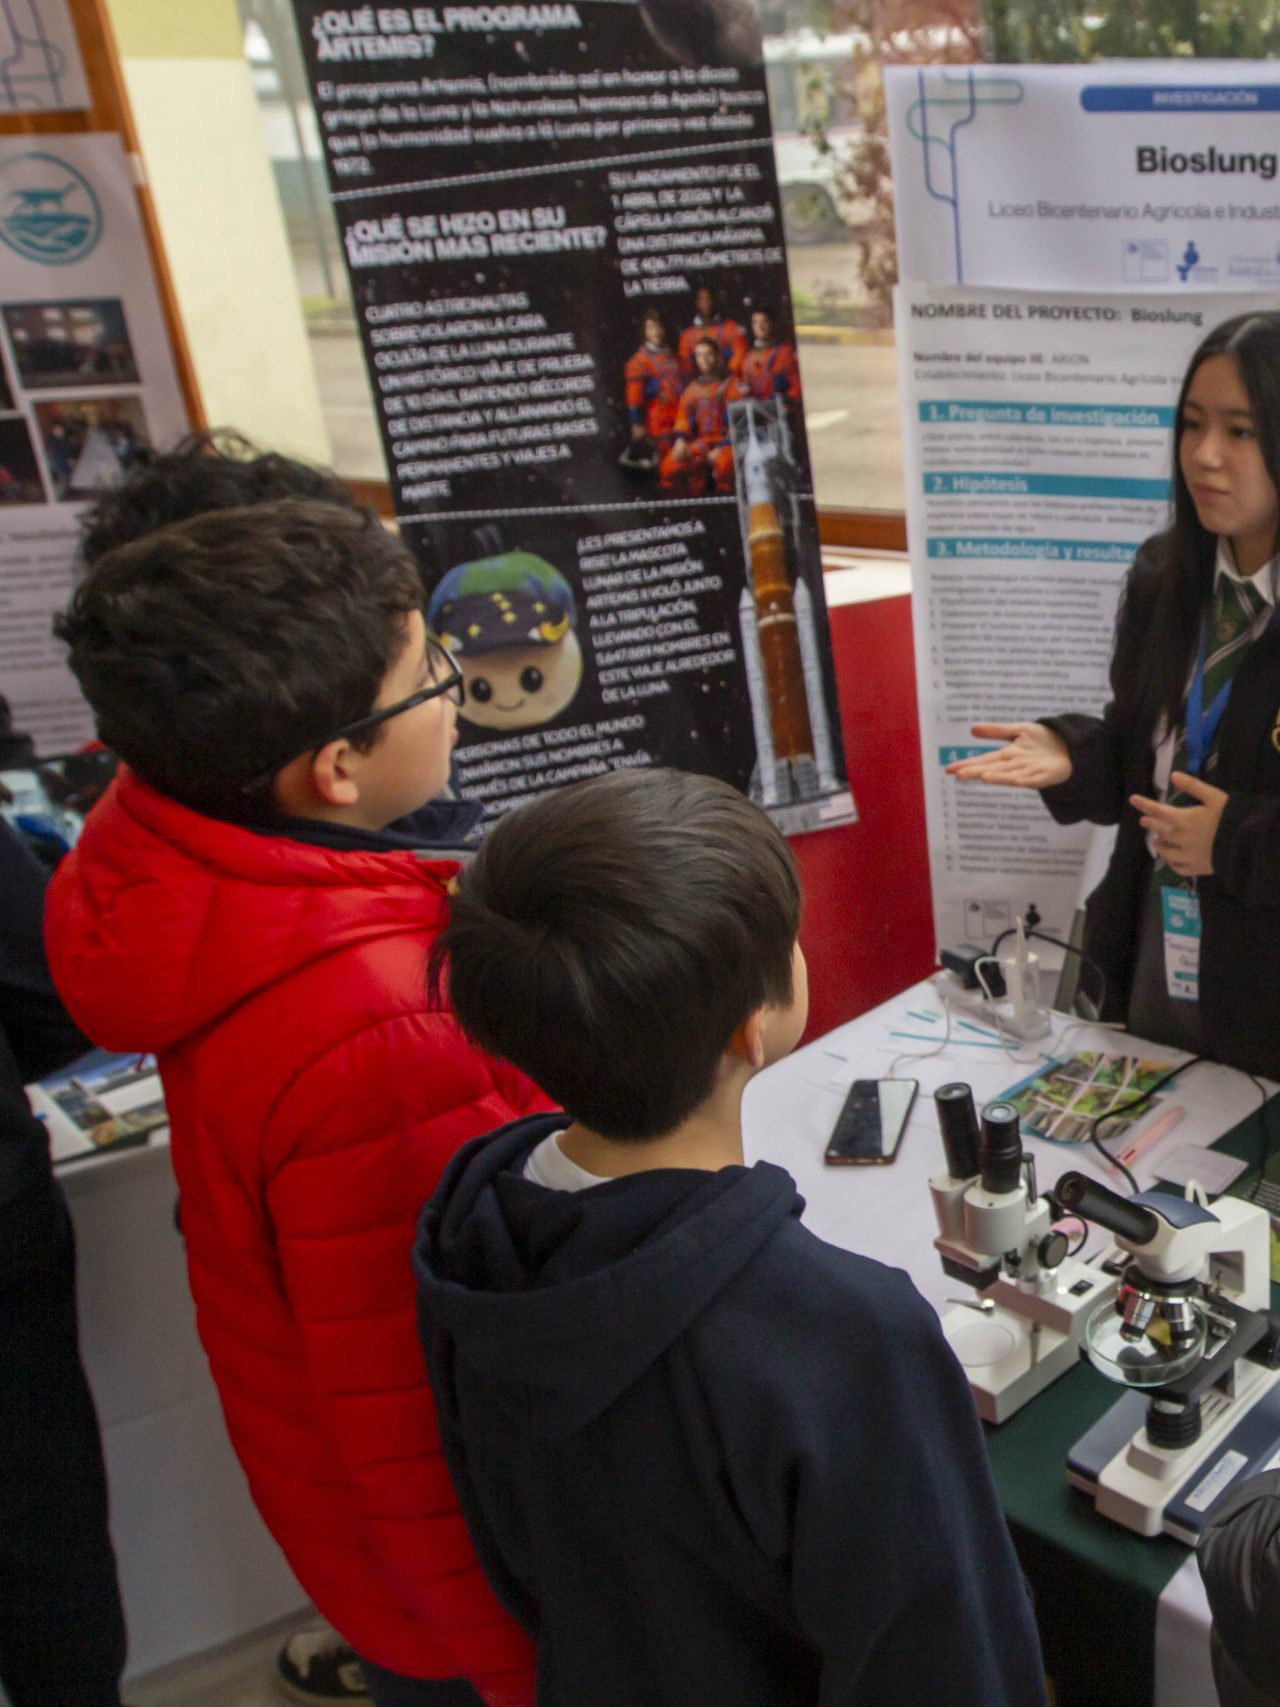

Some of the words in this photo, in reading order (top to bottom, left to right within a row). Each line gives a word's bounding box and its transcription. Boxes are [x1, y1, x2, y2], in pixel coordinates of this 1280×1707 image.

[311, 6, 375, 39] ¿QUÉ
[376, 9, 412, 32] ES
[411, 8, 443, 31] EL
[442, 5, 582, 29] PROGRAMA
[317, 34, 435, 59] ARTEMIS?
[317, 81, 334, 99] El
[335, 81, 420, 100] programa
[600, 72, 620, 86] en
[620, 70, 667, 85] honor
[668, 70, 680, 84] a
[679, 68, 697, 83] la
[697, 66, 738, 82] diosa
[322, 109, 378, 127] griega
[378, 106, 399, 121] de
[400, 105, 418, 121] la
[417, 105, 459, 120] Luna
[470, 101, 489, 117] la
[577, 96, 648, 111] hermana
[649, 94, 670, 108] de
[718, 90, 765, 107] busca
[327, 136, 359, 152] que
[360, 133, 378, 149] la
[377, 128, 473, 146] humanidad
[473, 126, 523, 141] vuelva
[537, 123, 554, 138] la
[553, 122, 592, 137] Luna
[593, 121, 620, 137] por
[621, 118, 681, 133] primera
[682, 117, 708, 130] vez
[708, 112, 755, 130] desde
[1136, 146, 1277, 173] Bioslung
[989, 203, 1033, 218] Liceo
[1036, 202, 1137, 220] Bicentenario
[1213, 206, 1225, 219] e
[343, 214, 405, 247] ¿QUÉ
[405, 215, 439, 238] SE
[437, 211, 497, 235] HIZO
[496, 209, 530, 231] EN
[529, 206, 566, 228] SU
[349, 238, 434, 266] MISIÓN
[489, 226, 607, 254] RECIENTE?
[365, 302, 424, 322] CUATRO
[424, 293, 529, 315] ASTRONAUTAS
[911, 302, 987, 319] NOMBRE
[992, 303, 1021, 319] DEL
[1028, 304, 1122, 321] PROYECTO:
[1131, 307, 1203, 325] Bioslung
[369, 320, 487, 344] SOBREVOLARON
[487, 317, 506, 334] LA
[505, 313, 547, 331] CARA
[374, 348, 428, 368] OCULTA
[428, 345, 449, 362] DE
[448, 344, 470, 360] LA
[469, 341, 507, 357] LUNA
[506, 333, 575, 353] DURANTE
[965, 353, 982, 362] del
[477, 360, 517, 379] VIAJE
[516, 358, 538, 375] DE
[537, 353, 594, 372] PRUEBA
[929, 406, 945, 419] 1.
[949, 406, 1021, 424] Pregunta
[1026, 408, 1046, 422] de
[1051, 409, 1159, 427] investigación
[392, 437, 450, 457] CAMINO
[449, 432, 488, 449] PARA
[487, 424, 552, 444] FUTURAS
[551, 418, 598, 437] BASES
[396, 453, 500, 477] PERMANENTES
[499, 451, 511, 465] Y
[509, 445, 559, 464] VIAJES
[558, 444, 571, 458] A
[932, 477, 948, 490] 2.
[953, 476, 1028, 493] Hipótesis
[576, 535, 602, 552] LES
[602, 523, 693, 546] PRESENTAMOS
[693, 519, 706, 533] A
[1063, 547, 1073, 561] y
[582, 572, 625, 589] LUNAR
[624, 568, 644, 584] DE
[642, 567, 660, 581] LA
[598, 667, 631, 684] ESTE
[630, 662, 664, 678] VIAJE
[664, 650, 736, 671] ALREDEDOR
[601, 687, 620, 703] DE
[619, 686, 636, 700] LA
[521, 733, 541, 749] DE
[541, 726, 579, 745] TODO
[578, 723, 595, 738] EL
[594, 715, 645, 734] MUNDO
[459, 779, 508, 800] TRAVÉS
[508, 775, 528, 790] DE
[526, 772, 546, 787] LA
